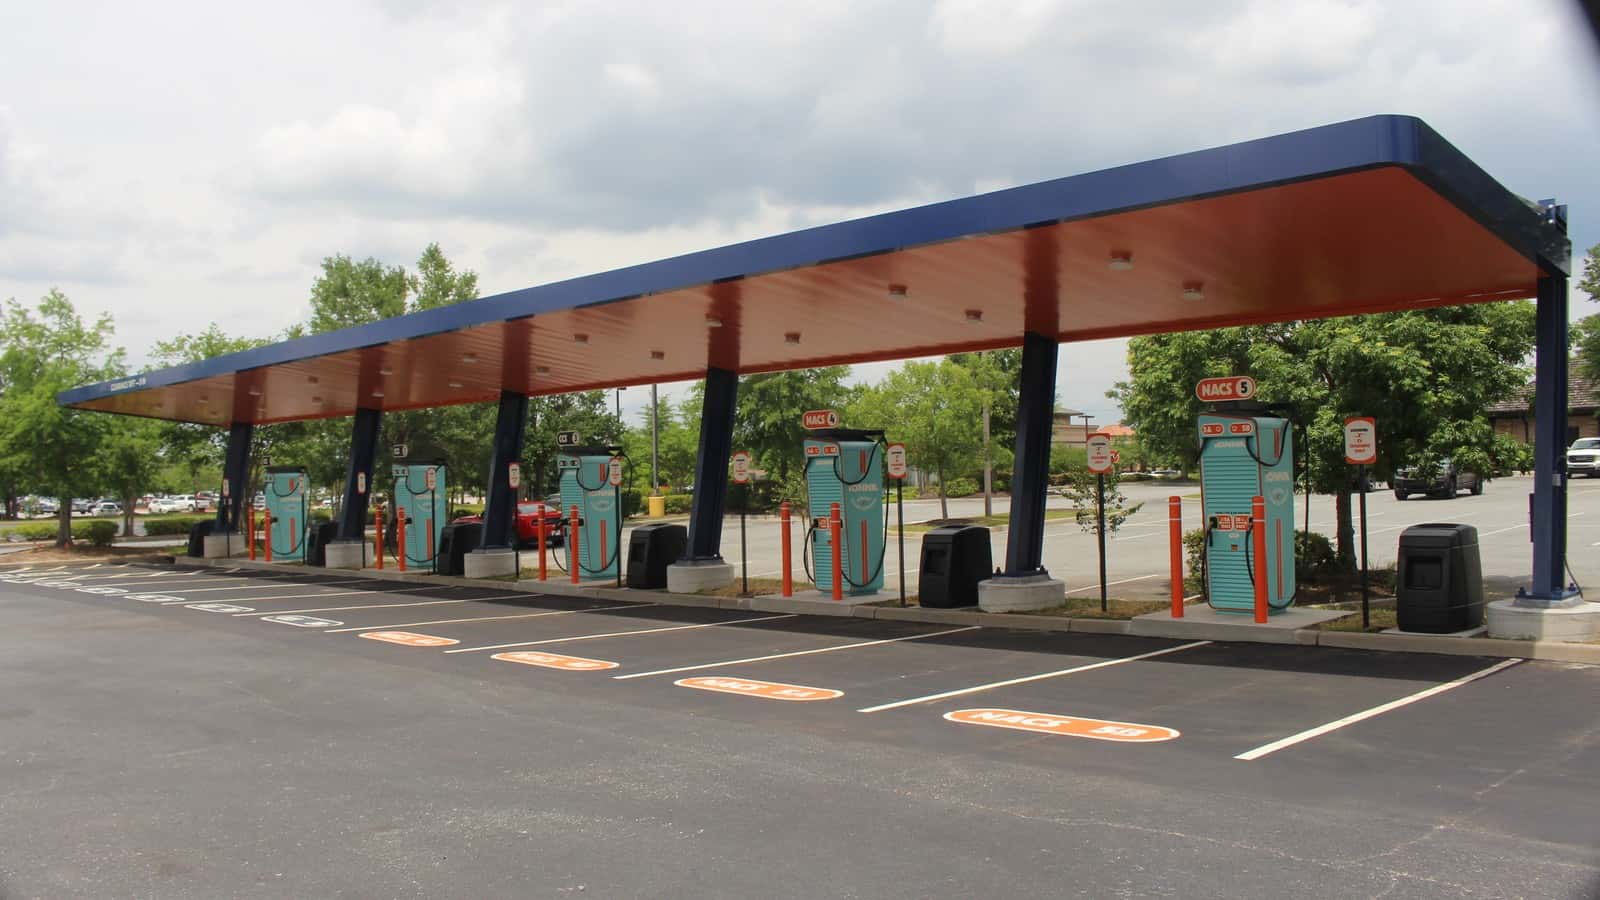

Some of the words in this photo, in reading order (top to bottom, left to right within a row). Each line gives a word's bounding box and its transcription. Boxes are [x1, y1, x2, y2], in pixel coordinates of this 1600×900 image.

[1202, 383, 1232, 396] NACS
[1240, 381, 1248, 393] 5
[806, 415, 825, 425] NACS
[968, 711, 1072, 728] NACS
